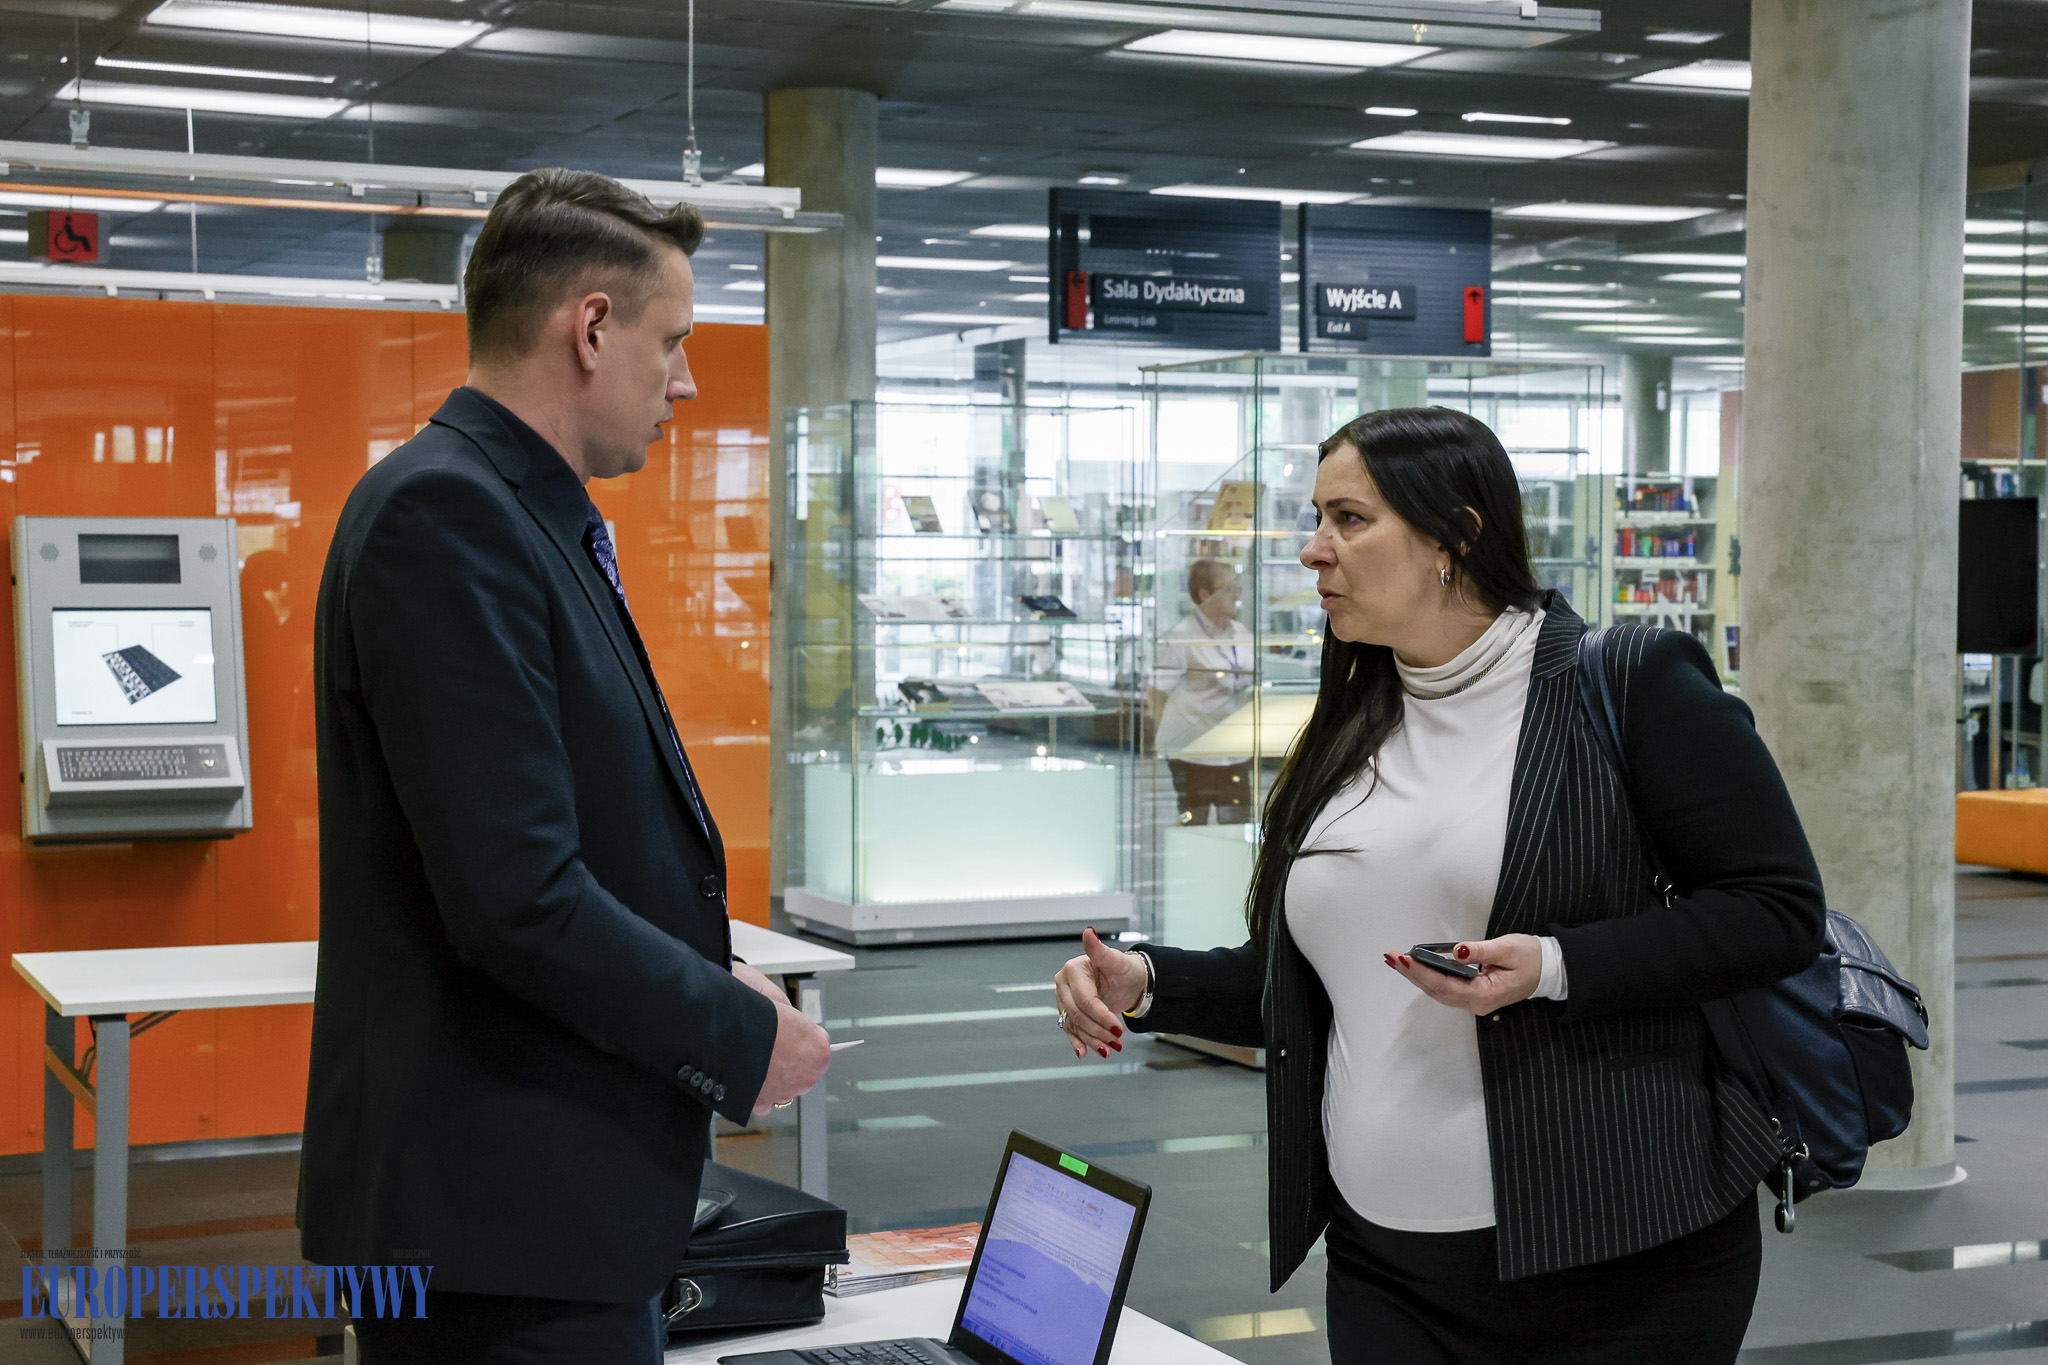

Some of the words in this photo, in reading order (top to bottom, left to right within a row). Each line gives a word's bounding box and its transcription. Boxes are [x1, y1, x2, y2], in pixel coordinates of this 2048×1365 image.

[1103, 279, 1138, 299] Sala
[1143, 281, 1245, 306] Dydaktyczna
[1326, 287, 1387, 312] Wyjście
[1388, 289, 1402, 310] A
